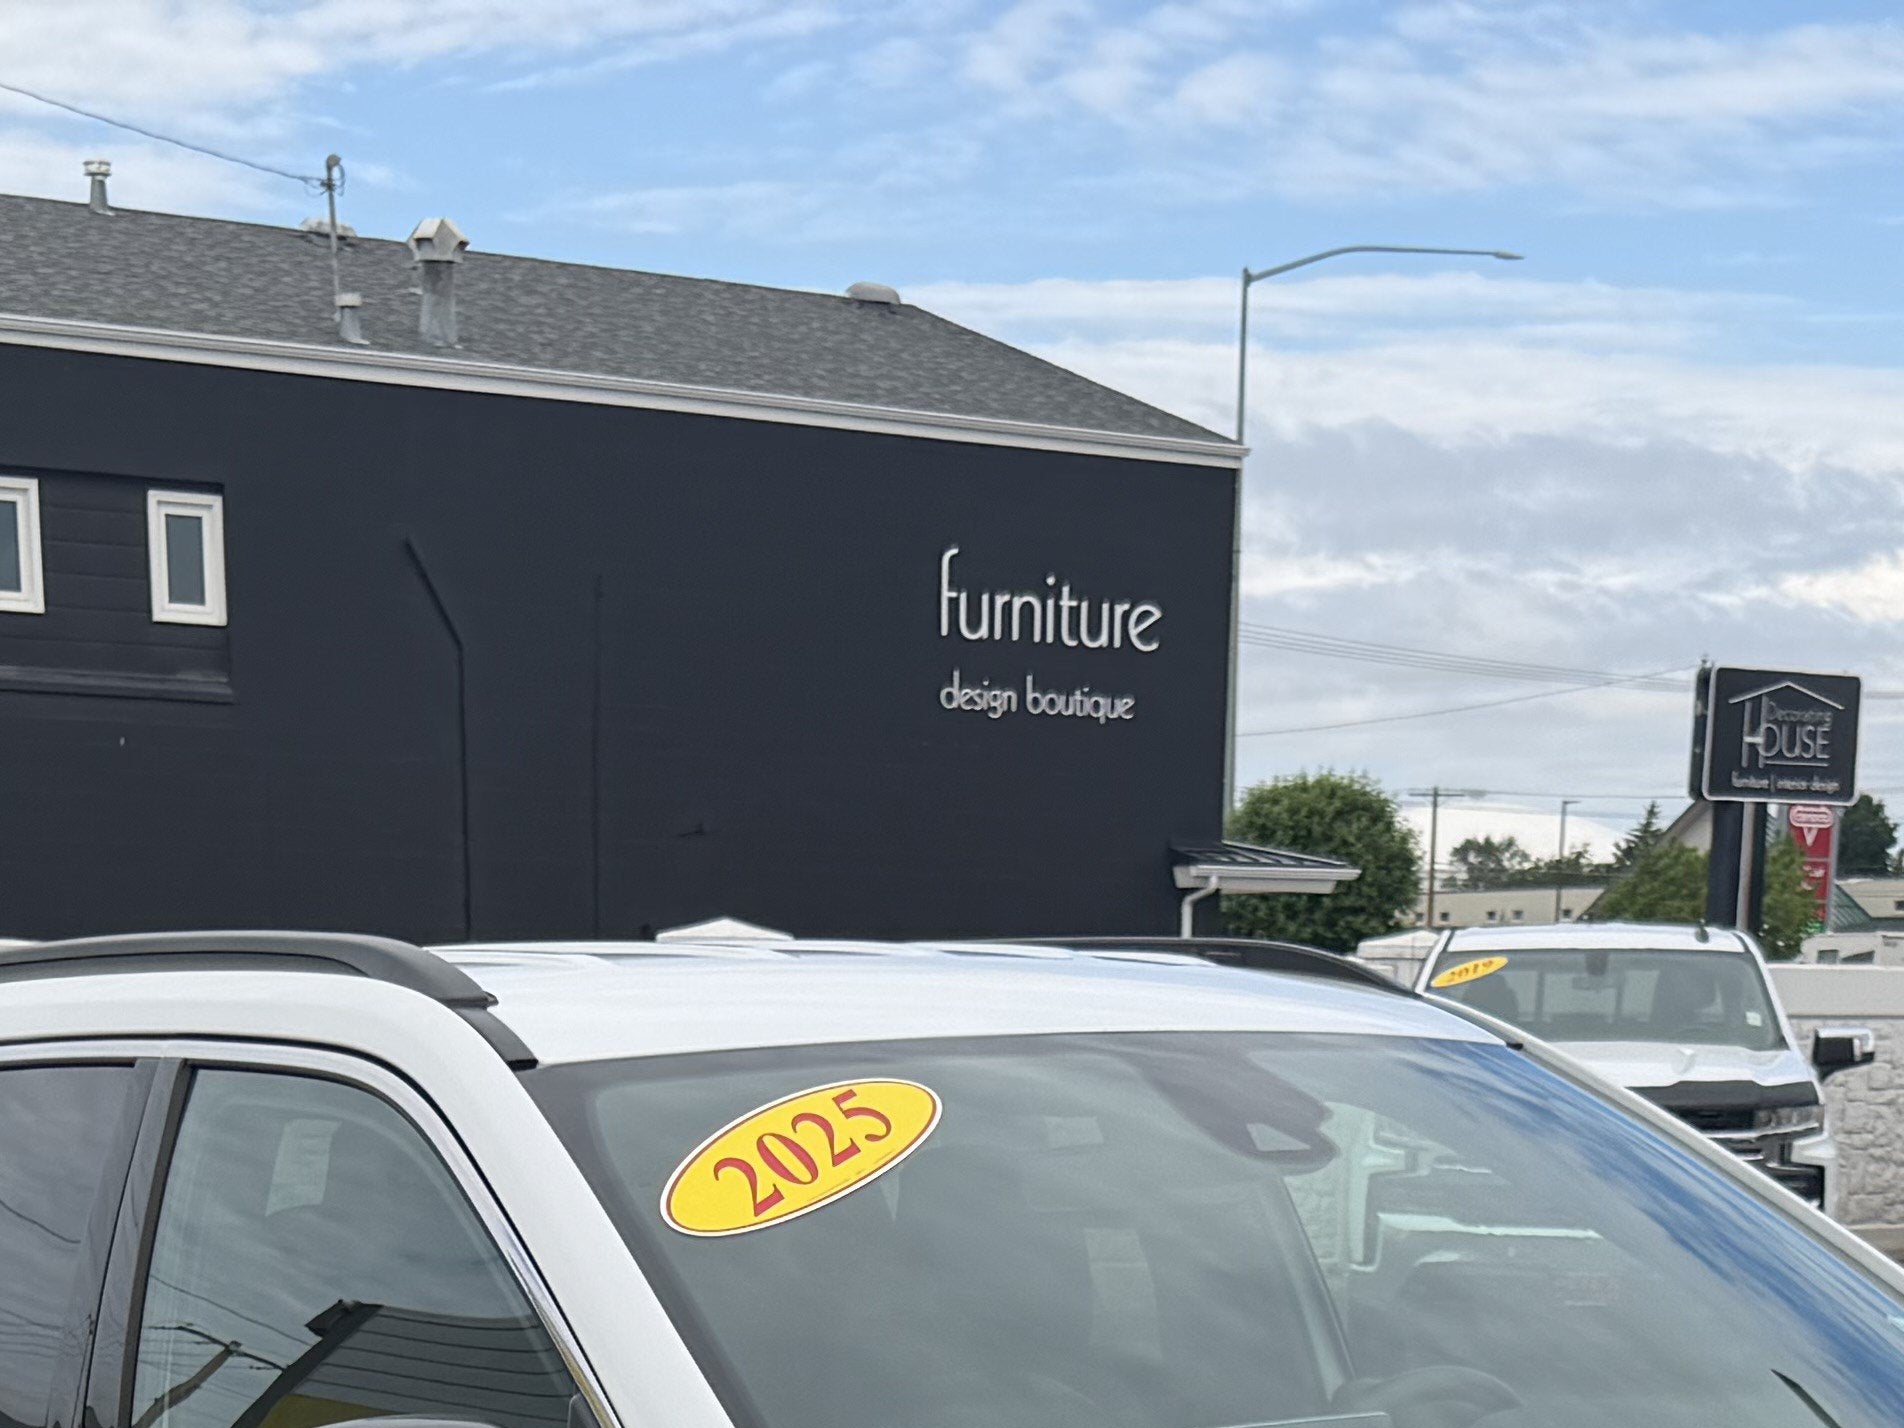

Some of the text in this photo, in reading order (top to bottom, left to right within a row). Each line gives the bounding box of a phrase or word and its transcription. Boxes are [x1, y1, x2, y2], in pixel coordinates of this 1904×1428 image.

[940, 544, 1163, 652] furniture
[940, 668, 1136, 724] design boutique
[1741, 694, 1831, 768] HOUSE
[1447, 959, 1494, 983] 2019
[713, 1089, 892, 1217] 2025
